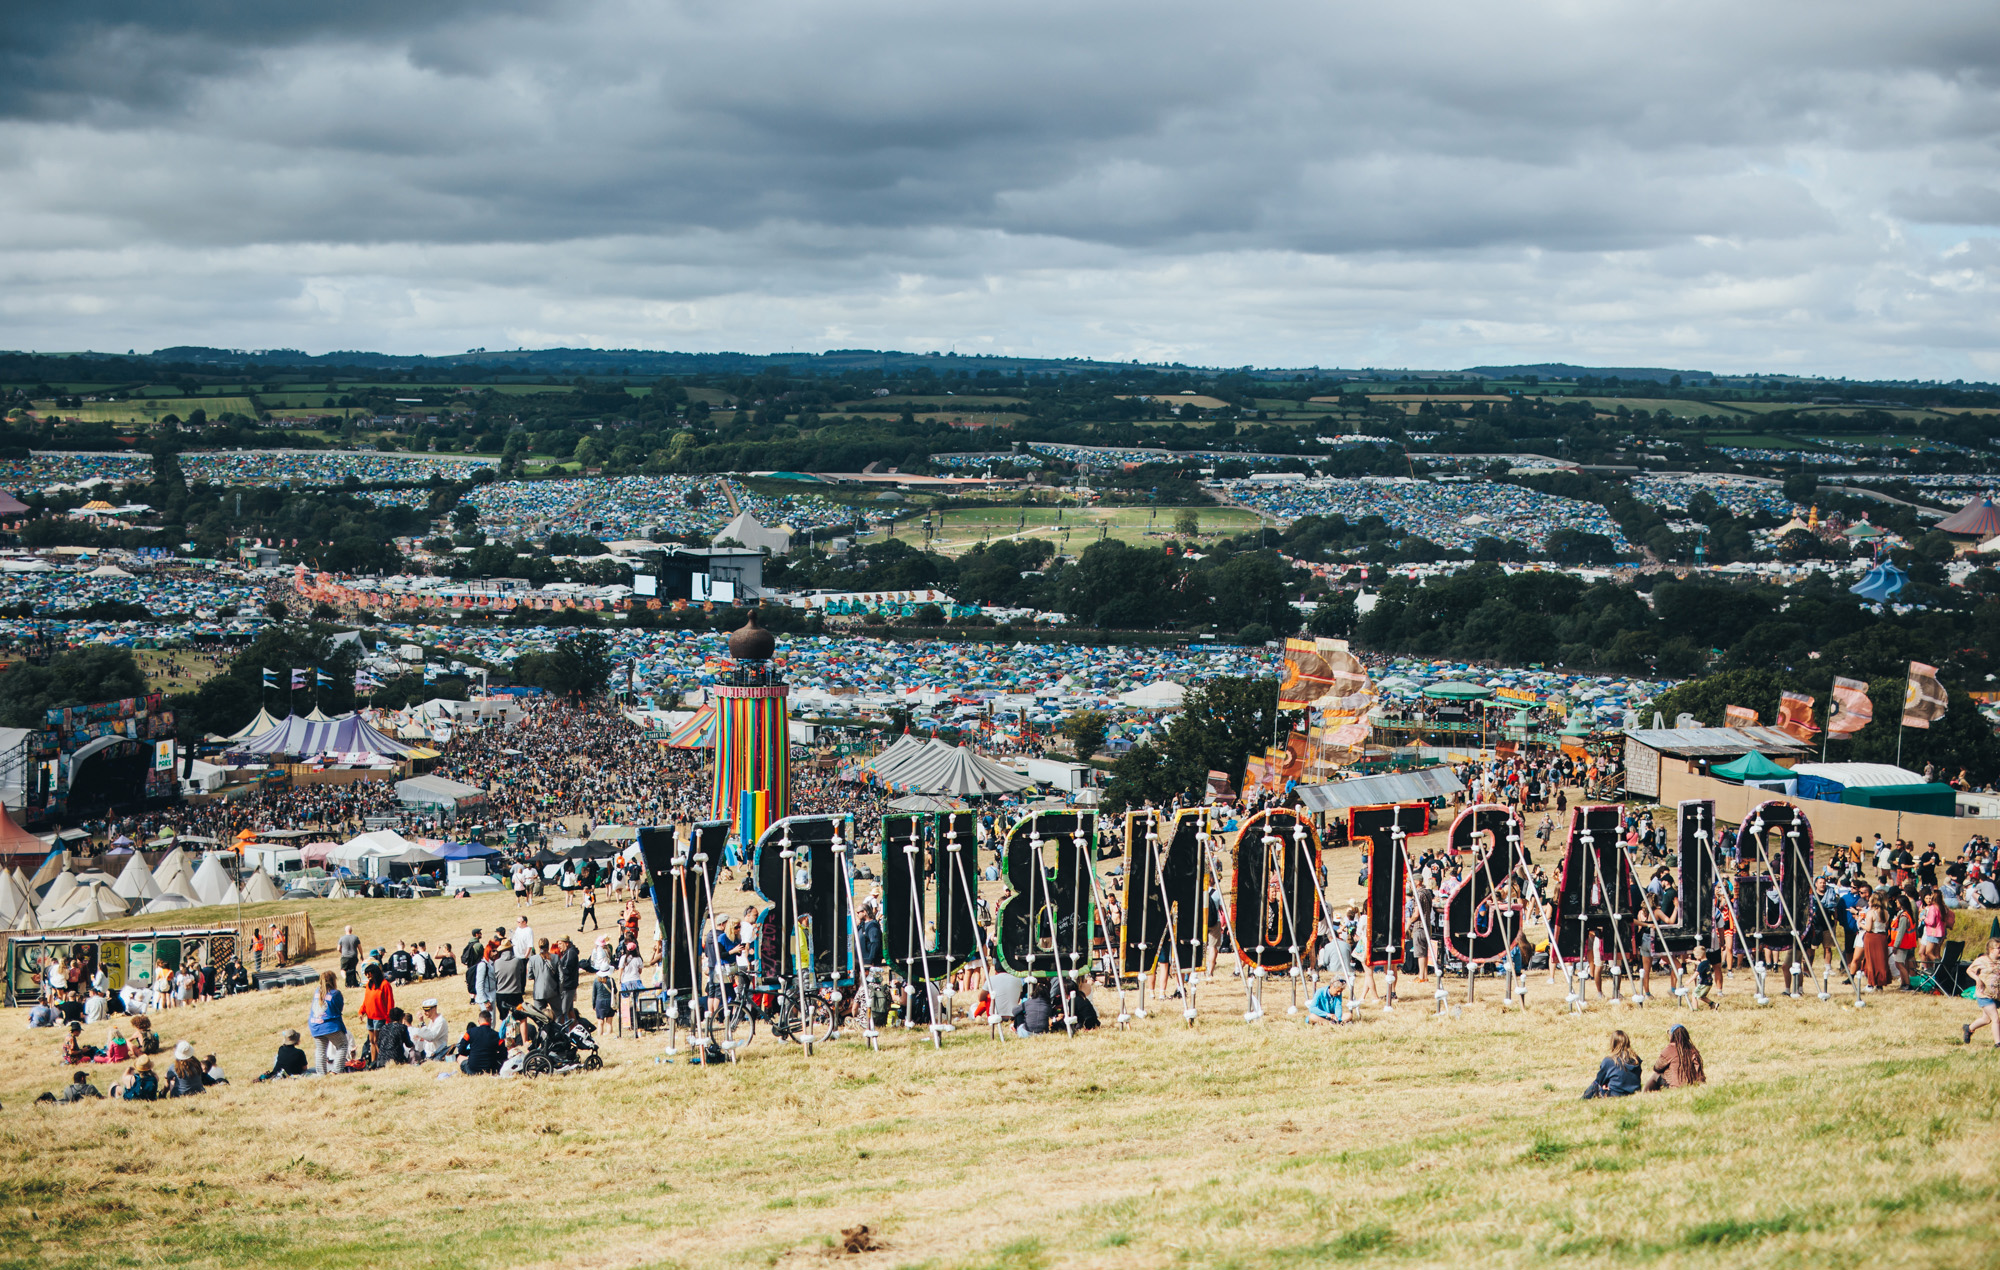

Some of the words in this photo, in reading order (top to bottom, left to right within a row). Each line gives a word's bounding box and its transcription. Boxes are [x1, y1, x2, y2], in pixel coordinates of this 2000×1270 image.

[1496, 687, 1519, 699] PINBALL
[1518, 691, 1537, 702] ALLEY
[158, 759, 172, 768] PARK
